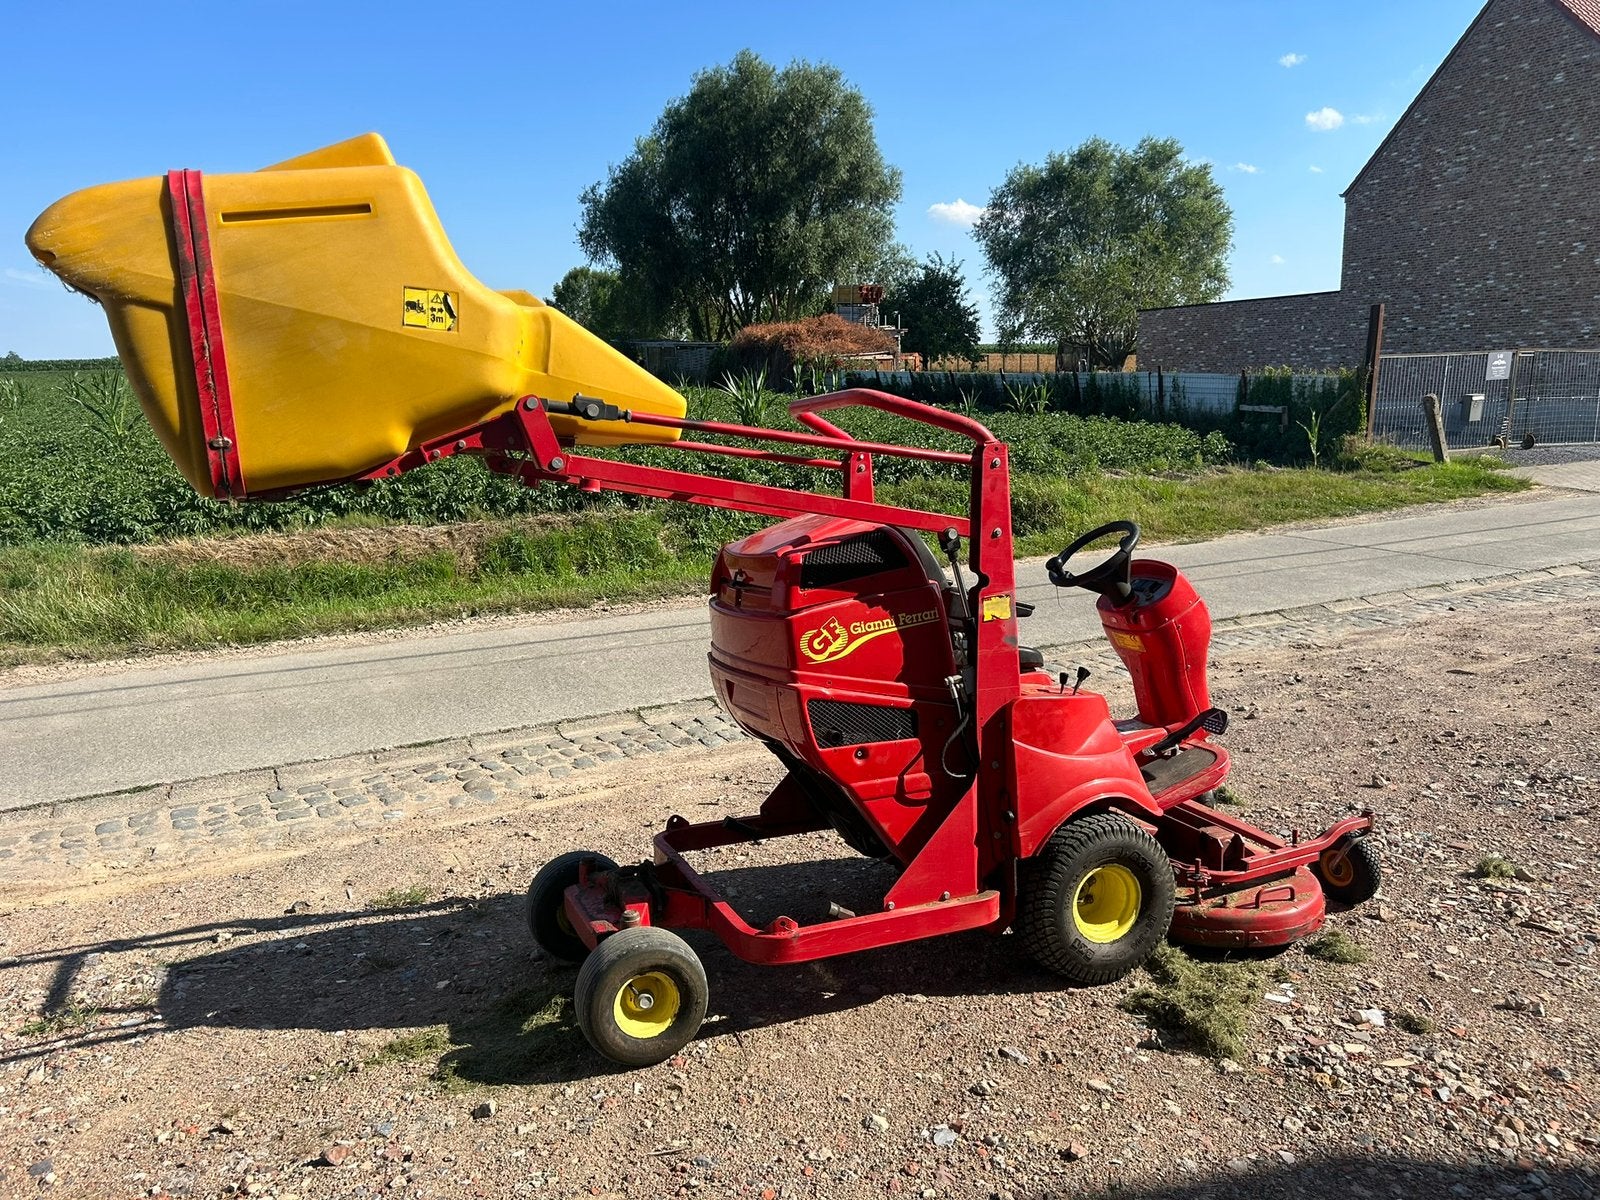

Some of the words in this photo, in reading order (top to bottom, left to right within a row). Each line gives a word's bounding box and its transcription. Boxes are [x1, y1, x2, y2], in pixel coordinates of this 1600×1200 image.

[430, 313, 444, 323] 3m
[850, 616, 896, 635] Gianni
[898, 607, 940, 626] Ferrari
